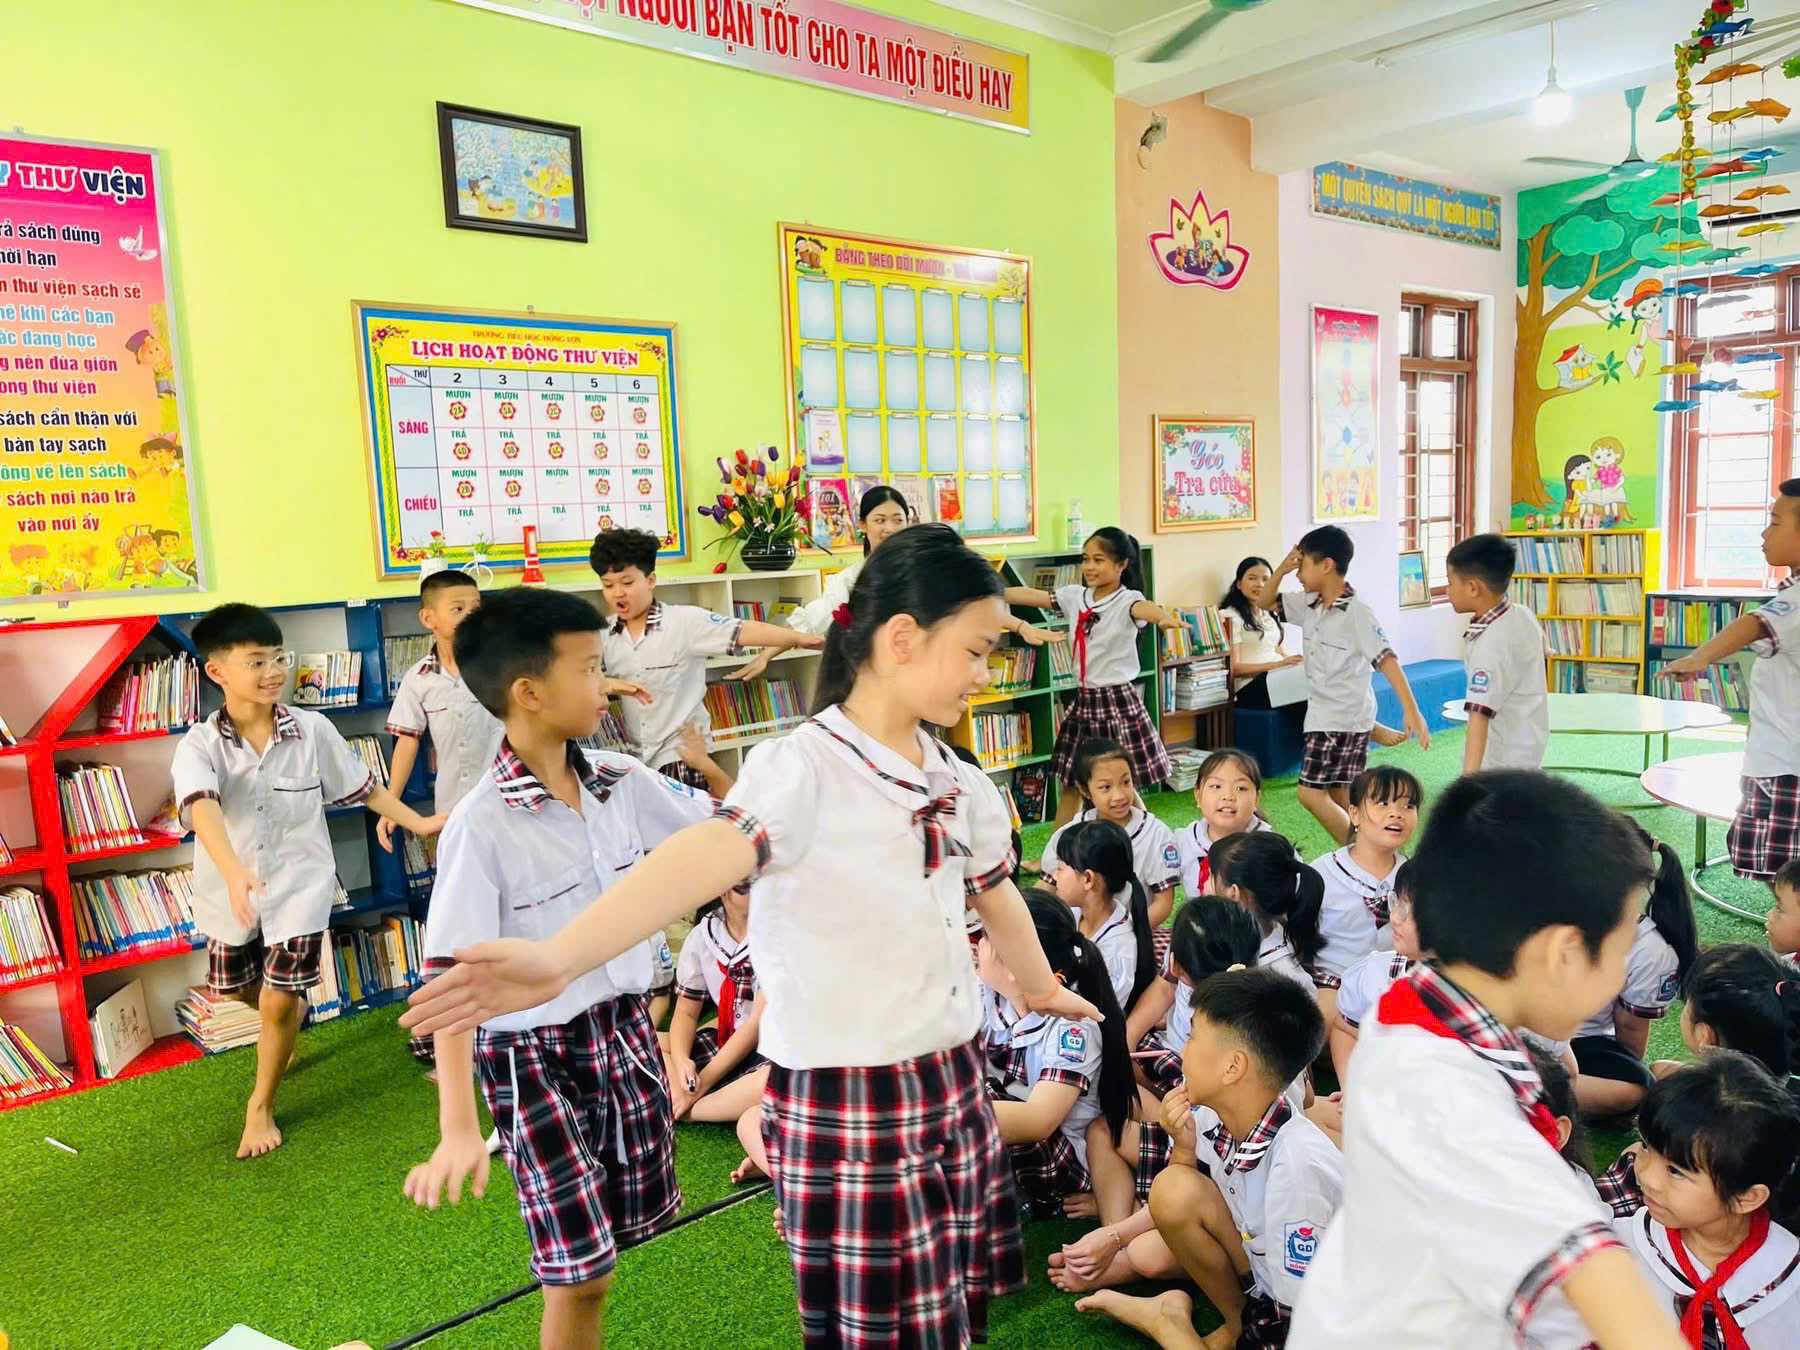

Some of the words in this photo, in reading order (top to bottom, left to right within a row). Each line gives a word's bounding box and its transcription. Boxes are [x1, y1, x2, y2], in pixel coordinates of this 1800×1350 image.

[761, 0, 799, 58] TỐT
[807, 20, 849, 70] CHO
[856, 34, 881, 78] TA
[886, 38, 927, 95] MỘT
[933, 44, 973, 100] ĐIỀU
[979, 66, 1012, 110] HAY
[18, 165, 75, 189] THƯ
[83, 168, 144, 202] VIỆN
[19, 223, 56, 240] sách
[27, 250, 56, 269] hạn
[13, 278, 38, 293] thư
[44, 279, 76, 298] viện
[82, 283, 119, 300] sạch
[21, 305, 46, 320] khi
[52, 307, 79, 322] các
[86, 309, 113, 327] bạn
[67, 332, 95, 348] học
[15, 354, 44, 370] nên
[412, 341, 453, 359] LỊCH
[459, 344, 506, 362] HOẠT
[512, 344, 559, 364] ĐỘNG
[563, 350, 597, 364] THƯ
[602, 348, 638, 368] VIỆN
[33, 379, 58, 394] thư
[64, 380, 96, 398] viện
[454, 373, 462, 383] 2
[499, 375, 507, 385] 3
[545, 377, 553, 387] 4
[591, 378, 598, 388] 5
[633, 380, 640, 390] 6
[75, 411, 109, 429] thận
[114, 411, 137, 426] với
[399, 419, 429, 434] SÁNG
[4, 437, 34, 452] bàn
[40, 438, 63, 453] tay
[69, 437, 107, 455] sạch
[89, 463, 126, 478] sách
[1175, 472, 1205, 496] Tra
[7, 491, 46, 506] sách
[51, 490, 75, 504] nơi
[81, 489, 109, 503] nào
[115, 488, 135, 502] trả
[405, 494, 437, 511] CHIỀU
[18, 517, 46, 532] vào
[52, 516, 76, 530] nơi
[1297, 1243, 1313, 1253] GD
